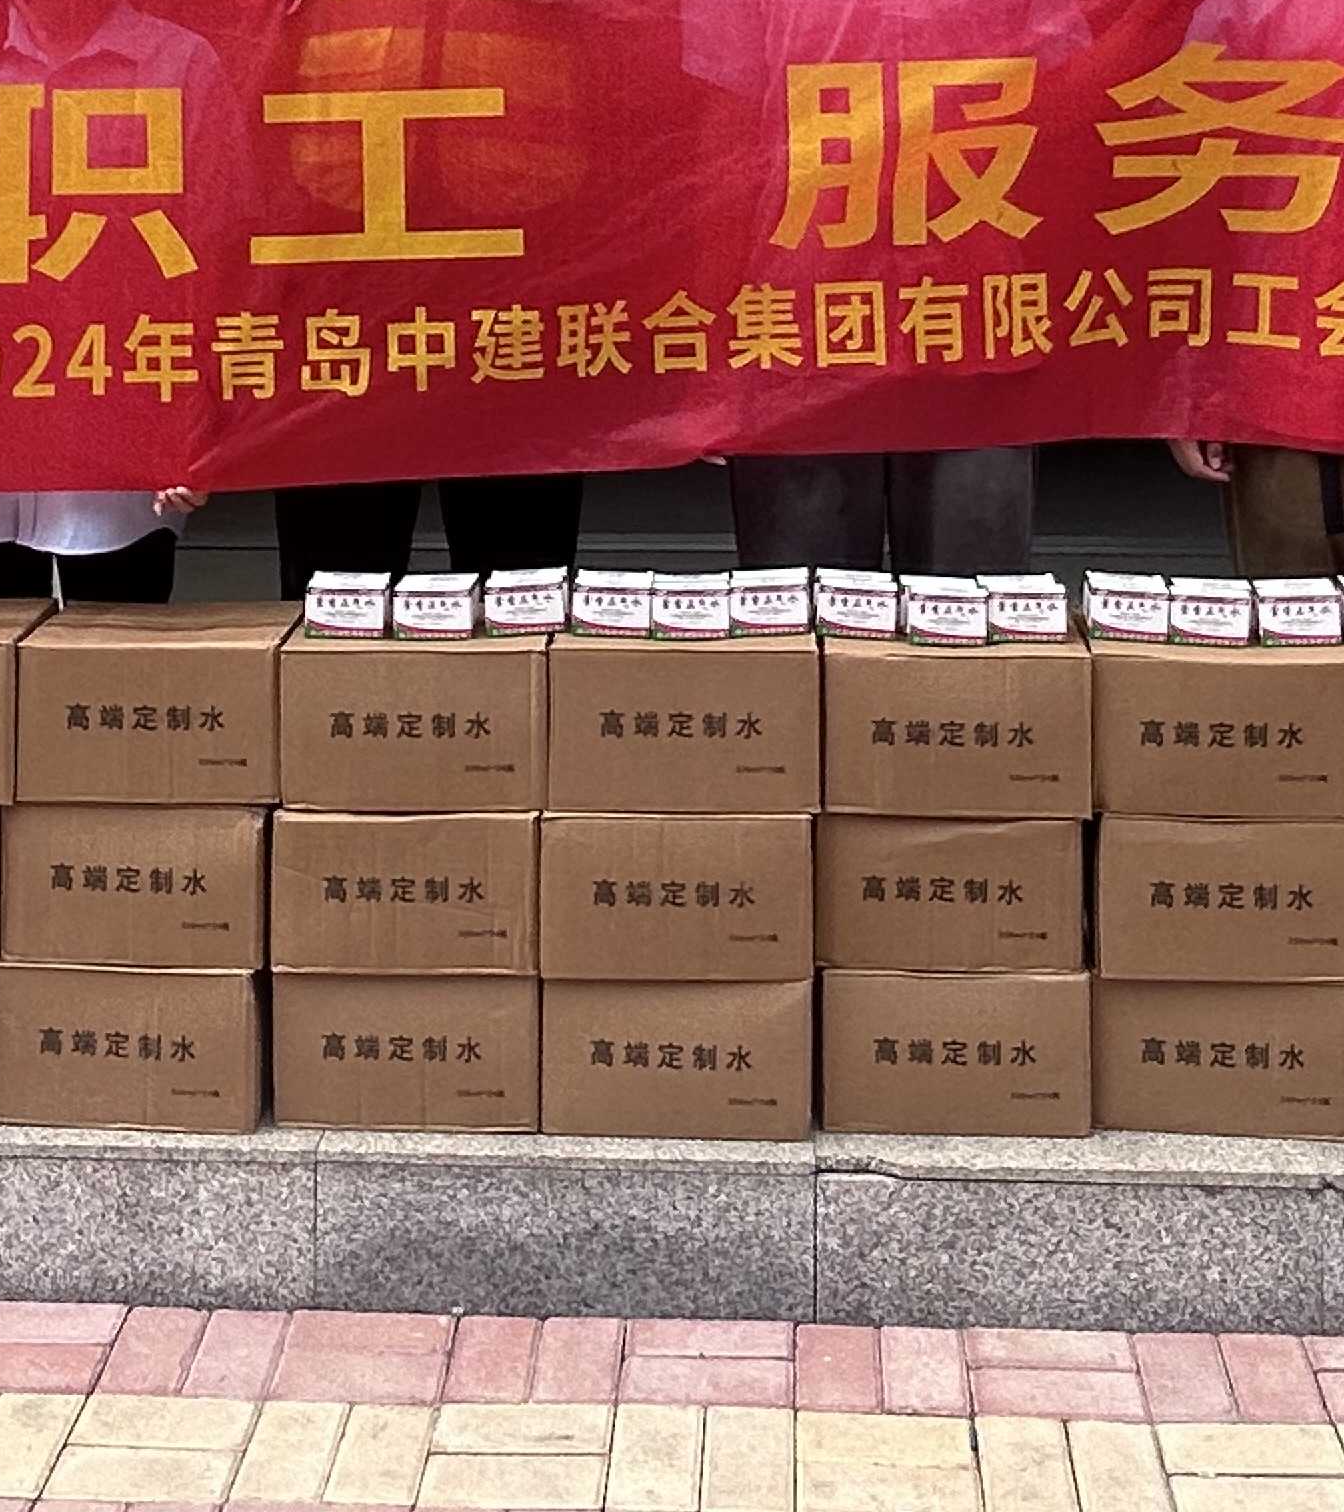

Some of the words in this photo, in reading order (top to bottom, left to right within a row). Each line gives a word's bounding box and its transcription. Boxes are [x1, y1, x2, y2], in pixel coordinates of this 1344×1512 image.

[65, 701, 225, 732] 高端定制水
[328, 709, 492, 740] 高端定制水
[599, 708, 763, 740] 高端定制水
[871, 715, 1035, 748] 高端定制水
[1139, 718, 1304, 750] 高端定制水
[50, 861, 208, 897] 高端定制水
[321, 874, 486, 905] 高端定制水
[592, 877, 756, 909] 高端定制水
[861, 873, 1024, 906] 高端定制水
[1149, 879, 1314, 912] 高端定制水
[38, 1025, 196, 1063] 高端定制水
[321, 1030, 482, 1064] 高端定制水
[589, 1037, 753, 1073] 高端定制水
[872, 1035, 1037, 1067] 高端定制水
[1141, 1035, 1305, 1071] 高端定制水
